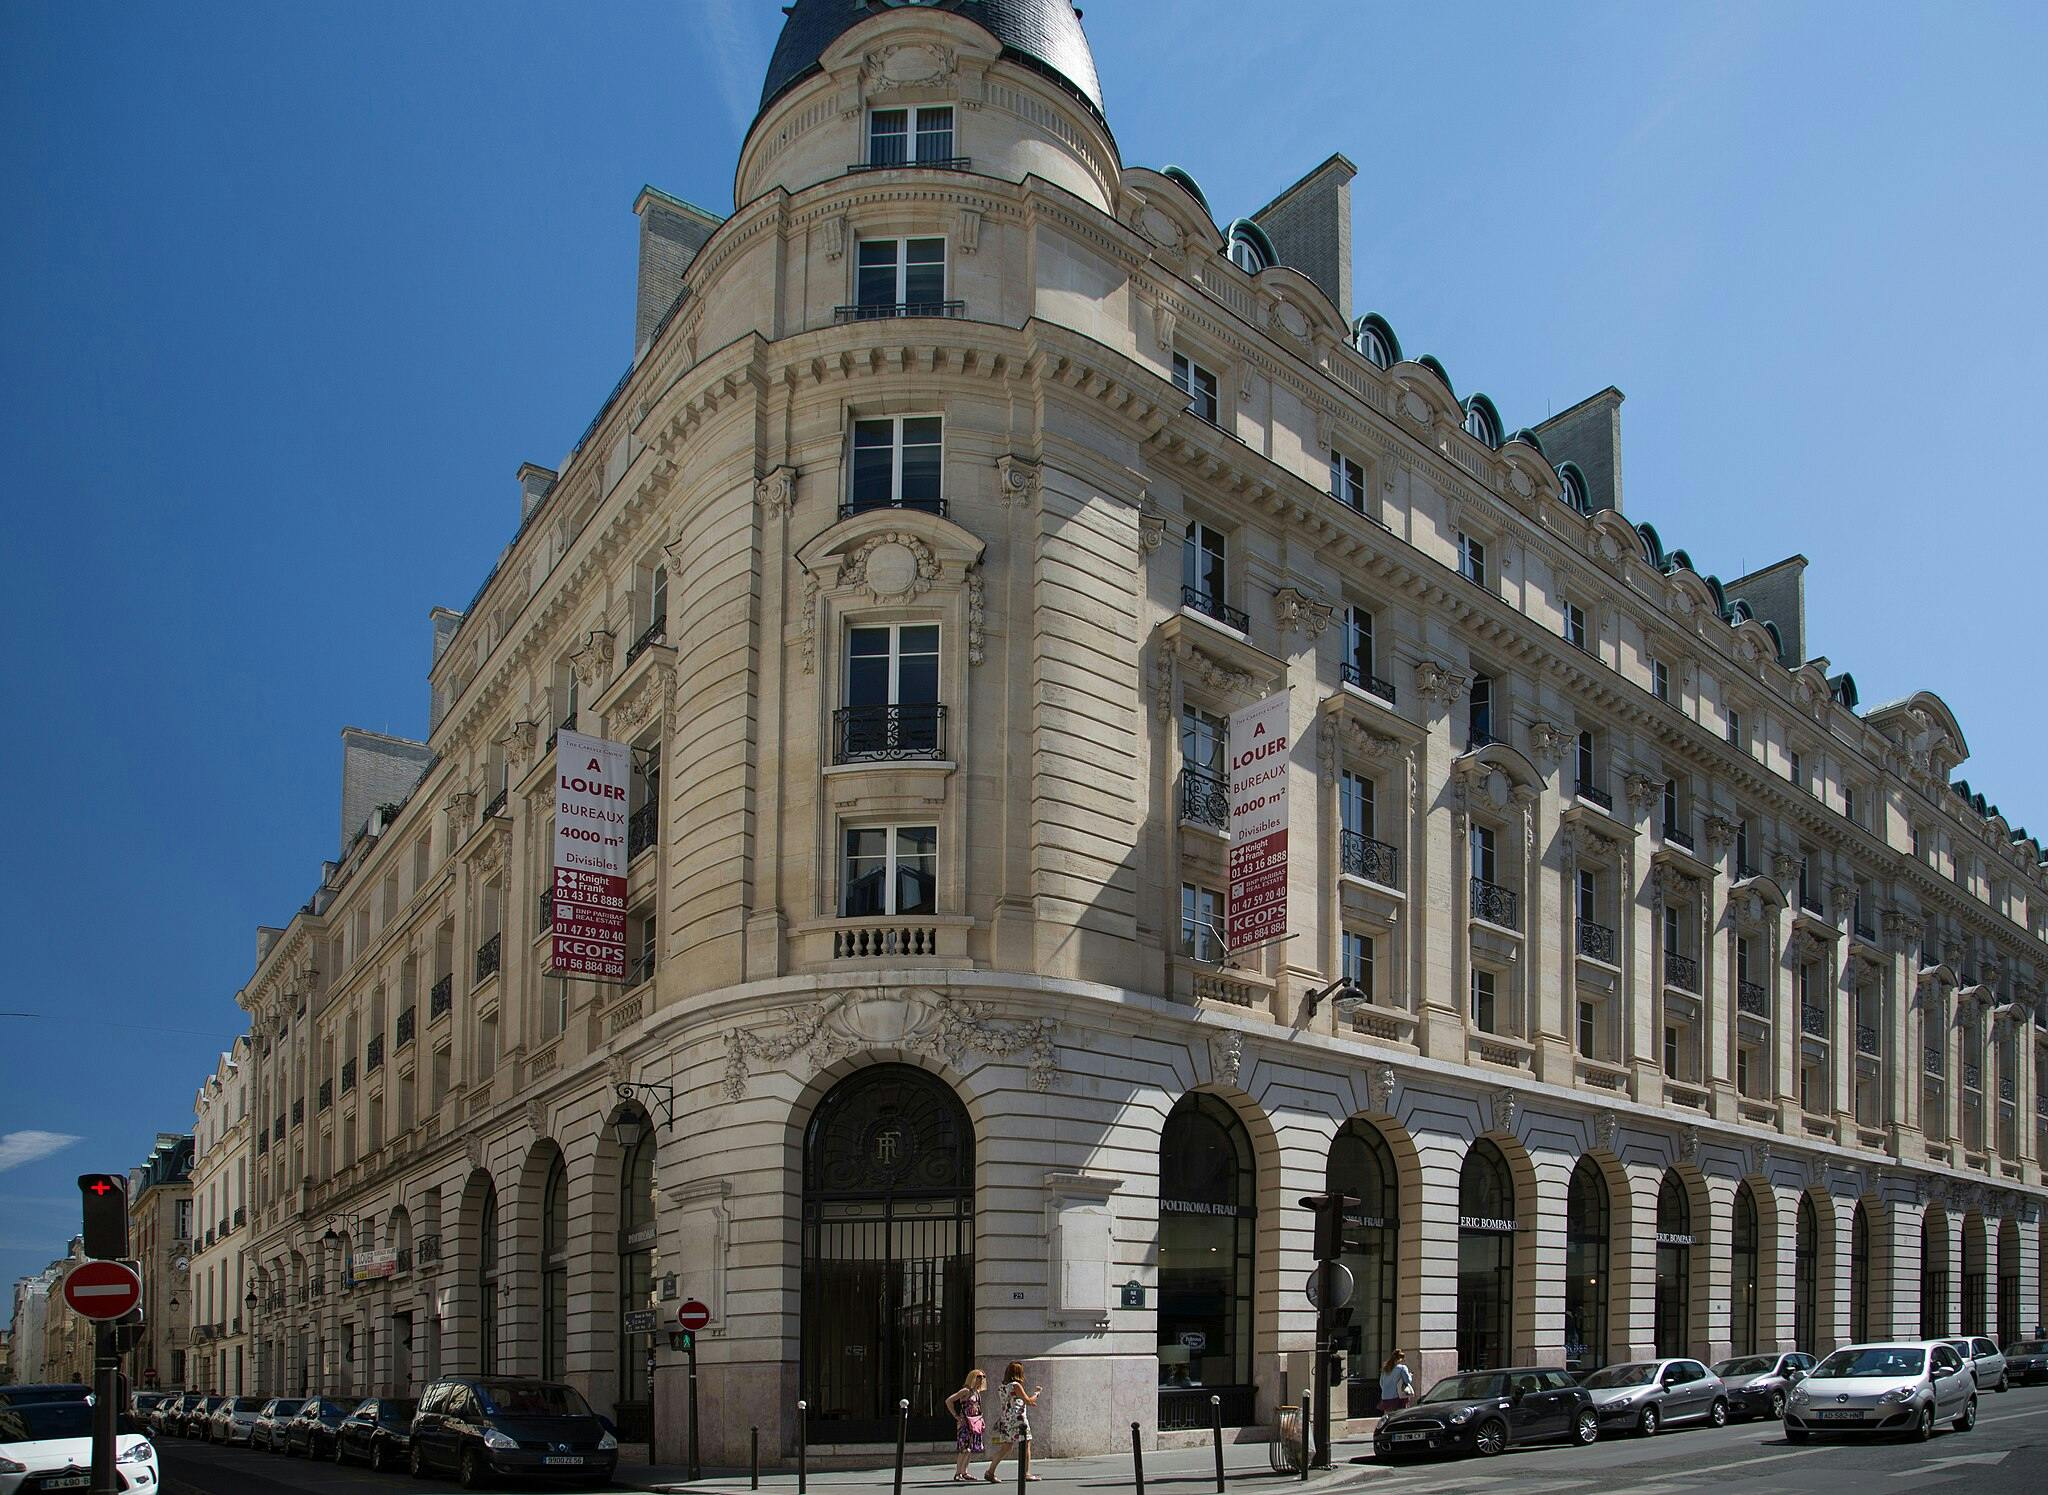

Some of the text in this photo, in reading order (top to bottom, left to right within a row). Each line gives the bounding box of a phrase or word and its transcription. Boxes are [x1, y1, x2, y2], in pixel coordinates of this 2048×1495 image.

[1253, 722, 1266, 738] A
[1233, 737, 1287, 770] LOUER
[586, 758, 601, 773] A
[561, 775, 626, 801] LOUER
[1233, 764, 1286, 794] BUREAUX
[561, 802, 625, 825] BUREAUX
[1233, 796, 1265, 817] 4000
[560, 827, 601, 843] 4000
[1238, 818, 1281, 841] Divisibles
[1245, 839, 1268, 853] Knight
[566, 852, 618, 871] Divisibles
[1232, 850, 1287, 879] 01 43 16 8888
[1245, 850, 1264, 862] Frank
[578, 882, 605, 894] Frank
[579, 873, 610, 886] Knight
[1246, 875, 1284, 893] REAL ESTATE
[556, 888, 624, 908] 01 43 16 8888
[1232, 886, 1286, 913] 01 47 59 20 40
[575, 914, 622, 927] REAL ESTATE
[576, 908, 624, 921] BNP PARIBAS
[1234, 904, 1286, 932] KEOPS
[556, 922, 624, 942] 01 47 59 20 40
[1232, 936, 1240, 947] 01
[1242, 931, 1252, 943] 56
[1254, 927, 1268, 939] 884
[1270, 921, 1285, 934] 884
[559, 940, 624, 961] KEOPS
[556, 957, 567, 967] 01
[570, 958, 583, 969] 56
[585, 961, 603, 973] 884
[605, 964, 623, 975] 884
[1161, 1200, 1237, 1216] POLTRONA FRAU
[1364, 1217, 1384, 1227] FRAU
[1460, 1217, 1518, 1230] ERIC BOMPARD
